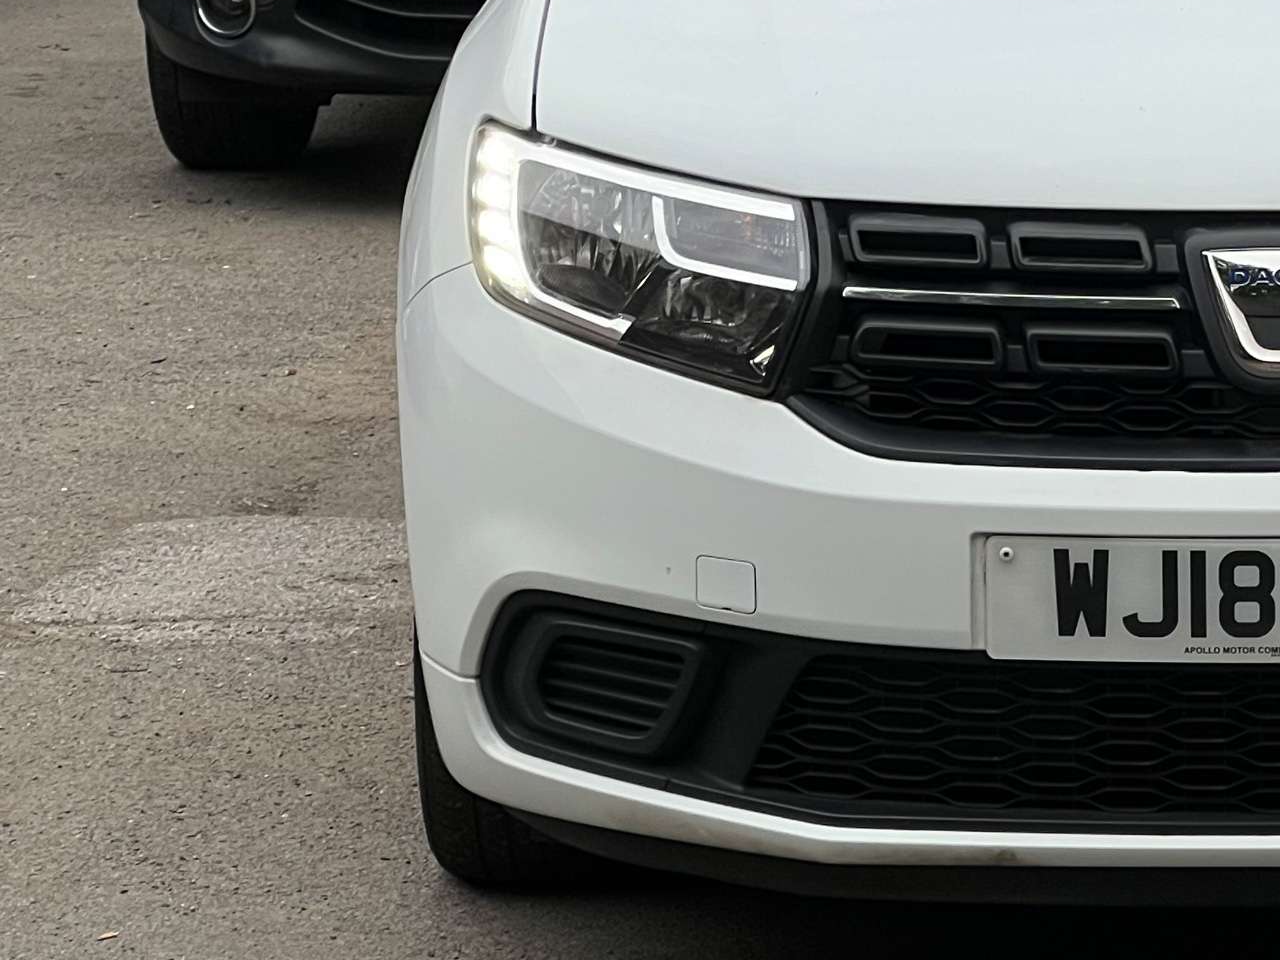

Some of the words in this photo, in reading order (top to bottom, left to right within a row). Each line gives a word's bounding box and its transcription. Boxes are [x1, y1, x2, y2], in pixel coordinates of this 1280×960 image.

[1053, 548, 1276, 638] WJ18
[1184, 646, 1220, 655] APOLLO
[1223, 646, 1255, 655] MOTOR
